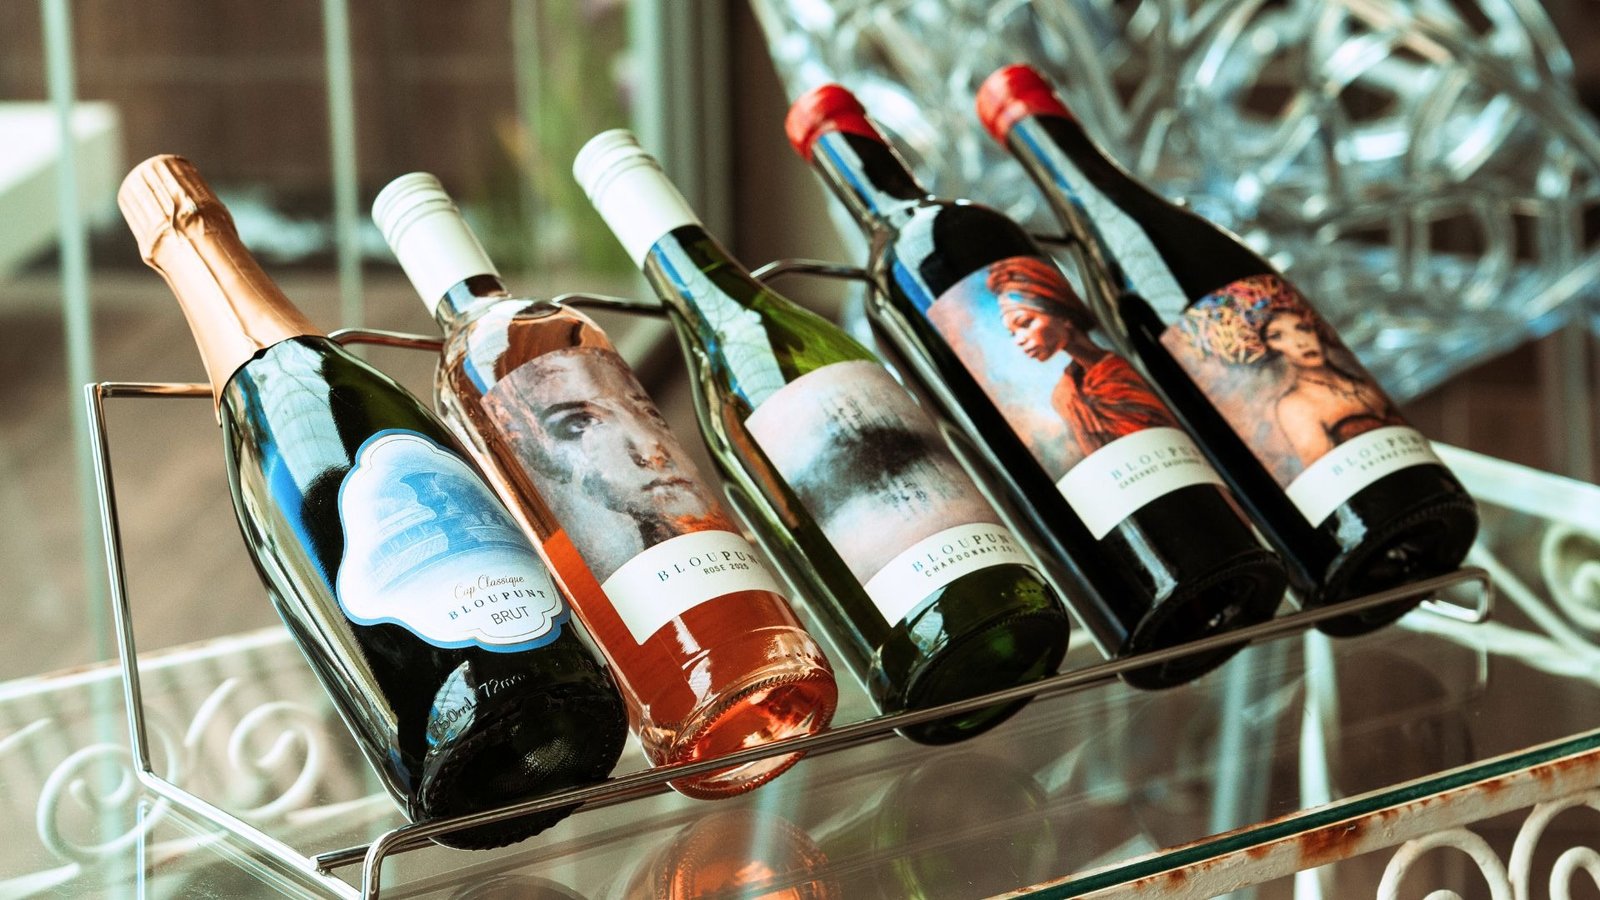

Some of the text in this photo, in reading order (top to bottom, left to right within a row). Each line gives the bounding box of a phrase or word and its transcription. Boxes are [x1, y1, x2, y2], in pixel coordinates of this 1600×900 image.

[657, 550, 759, 582] BLOUPUN
[912, 533, 1009, 572] BLOUPUN
[925, 545, 998, 578] CHARDONNAY
[703, 564, 726, 575] ROSE
[454, 573, 525, 600] Cap Classique
[448, 589, 546, 620] BLOUPUNT
[490, 605, 530, 625] BRUT
